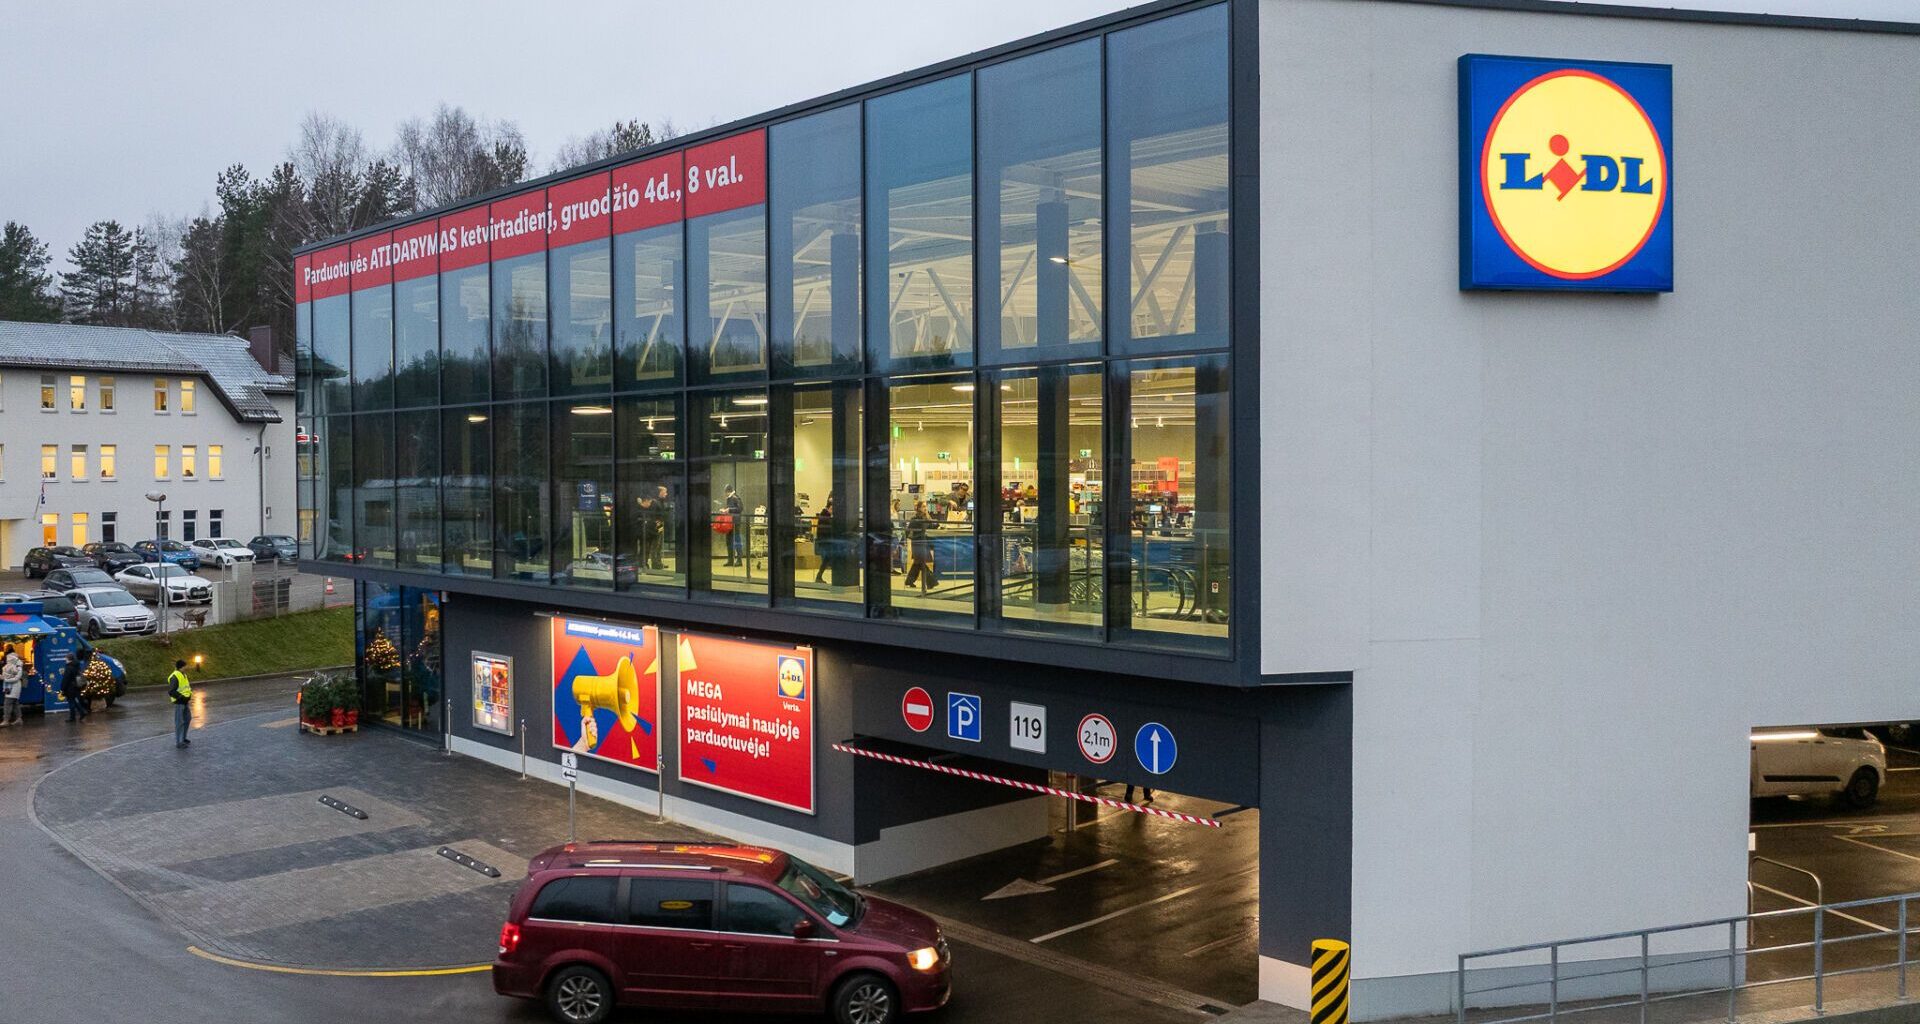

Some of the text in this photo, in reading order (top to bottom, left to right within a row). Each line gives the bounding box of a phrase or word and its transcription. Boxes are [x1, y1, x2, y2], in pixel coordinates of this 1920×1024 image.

[303, 154, 744, 286] Parduotuvės ATIDARYMAS ketvirtadienį, gruodžio 4d., 8 val.
[686, 679, 723, 701] MEGA
[686, 704, 800, 742] pasiūlymai naujoje
[957, 705, 974, 736] P
[1014, 715, 1042, 740] 119
[686, 727, 770, 759] parduotuvėje!
